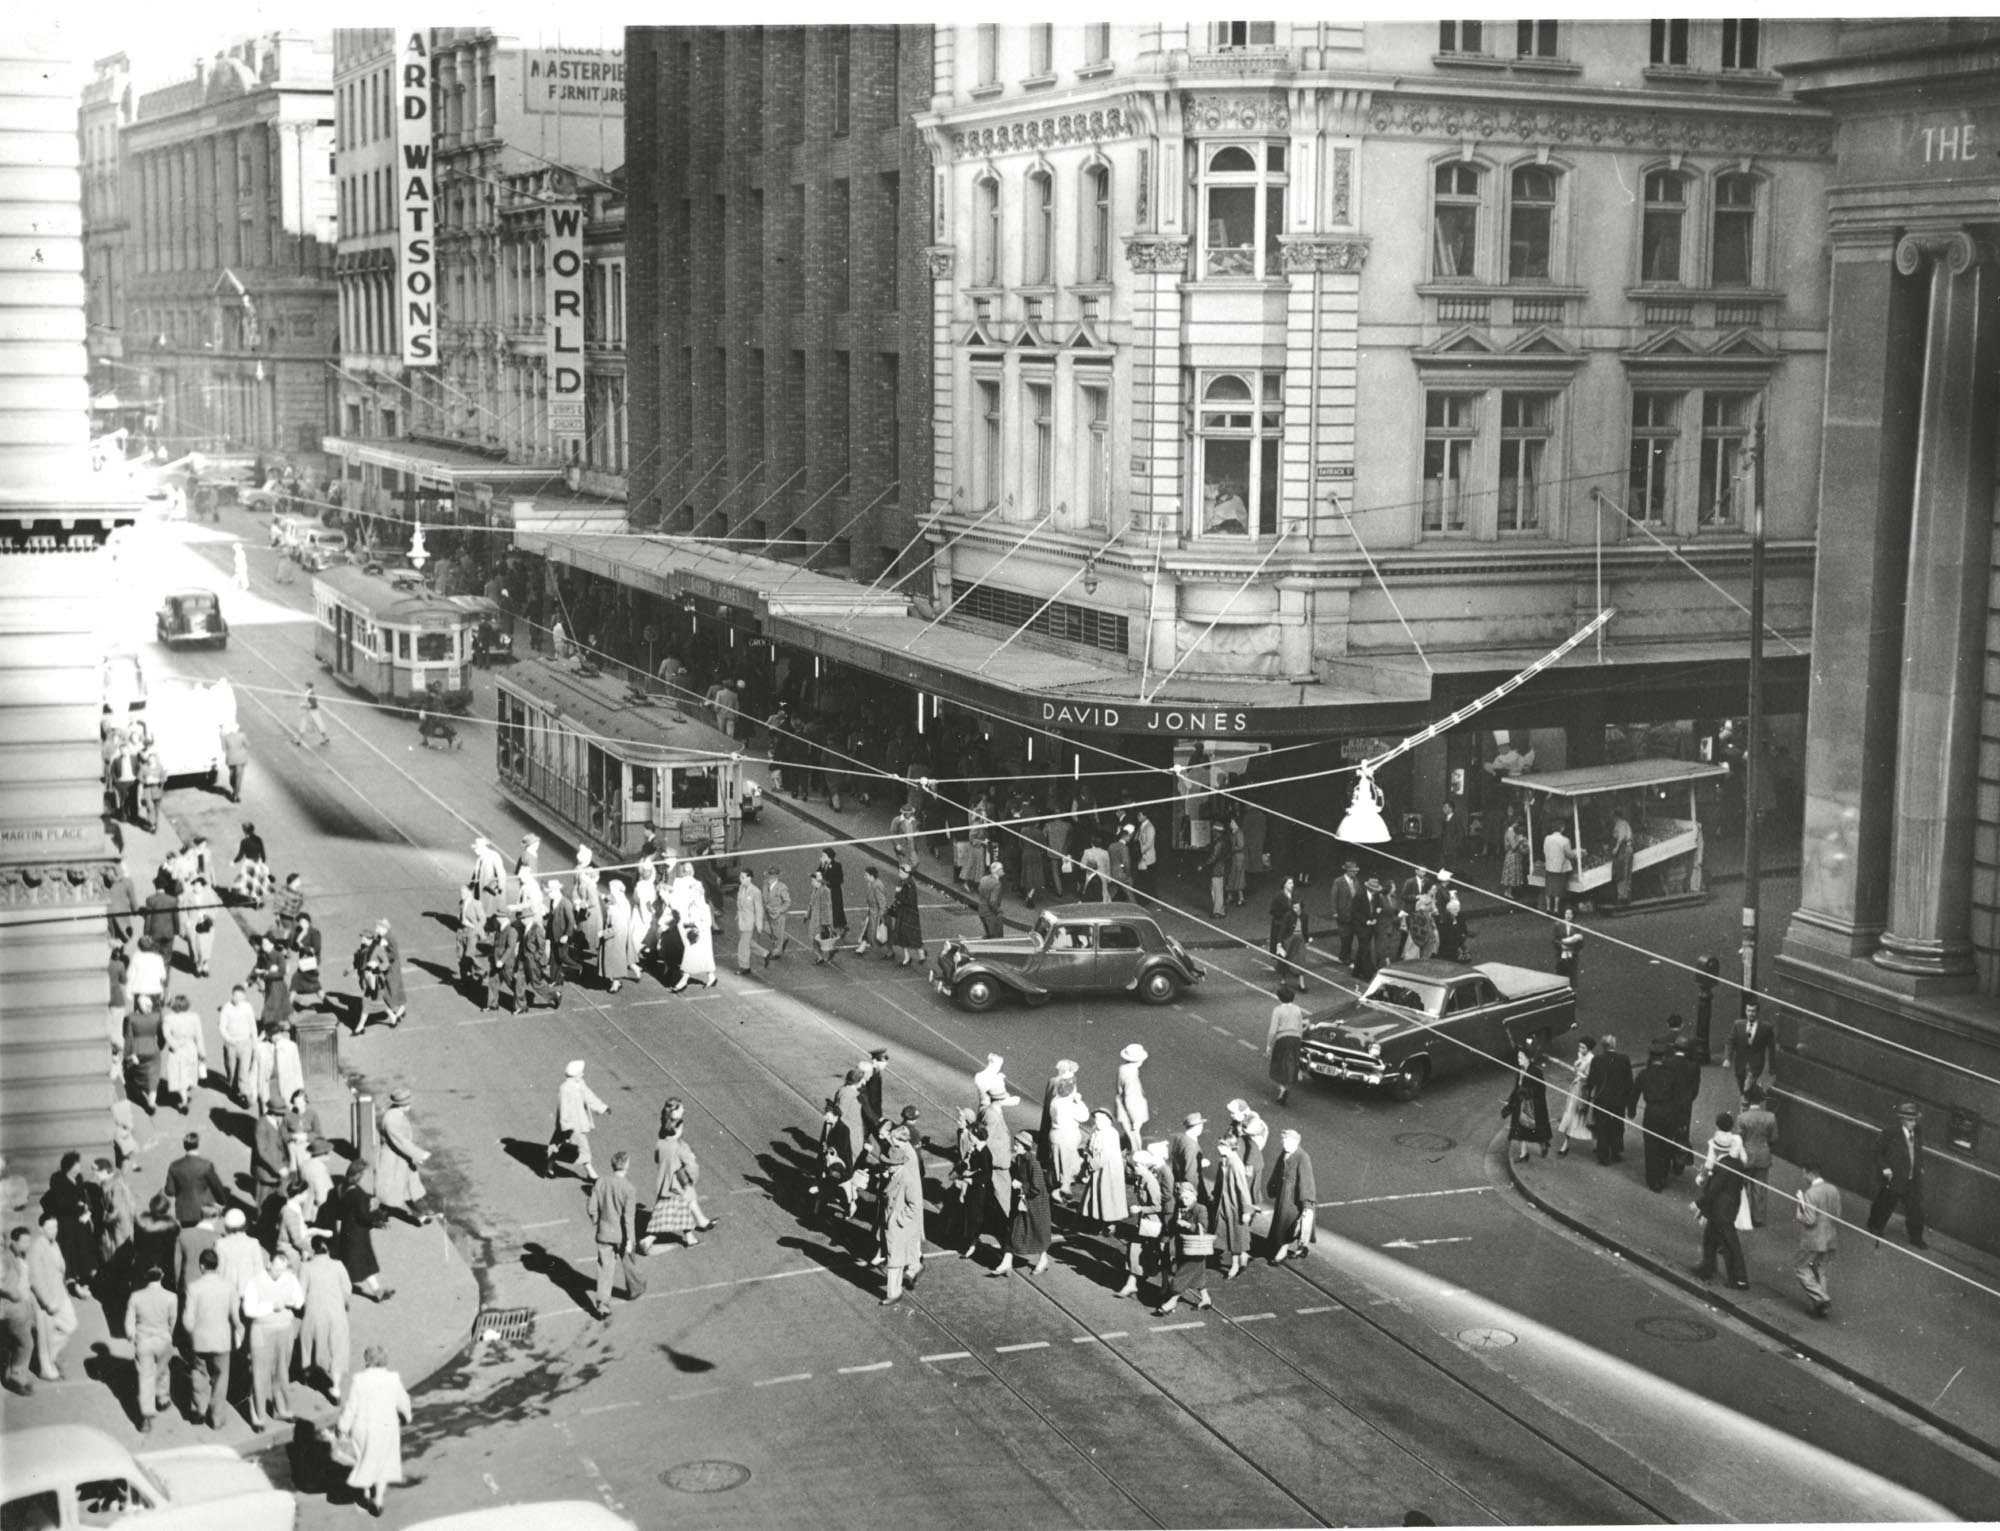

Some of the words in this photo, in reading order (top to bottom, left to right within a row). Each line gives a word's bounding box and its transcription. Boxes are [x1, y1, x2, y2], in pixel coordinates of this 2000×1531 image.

[548, 84, 627, 102] FURNITURE
[1921, 124, 1978, 162] THE
[551, 209, 582, 394] WORLD
[1043, 703, 1119, 727] DAVID
[1148, 712, 1247, 731] JONES
[1, 830, 43, 842] MARTIN
